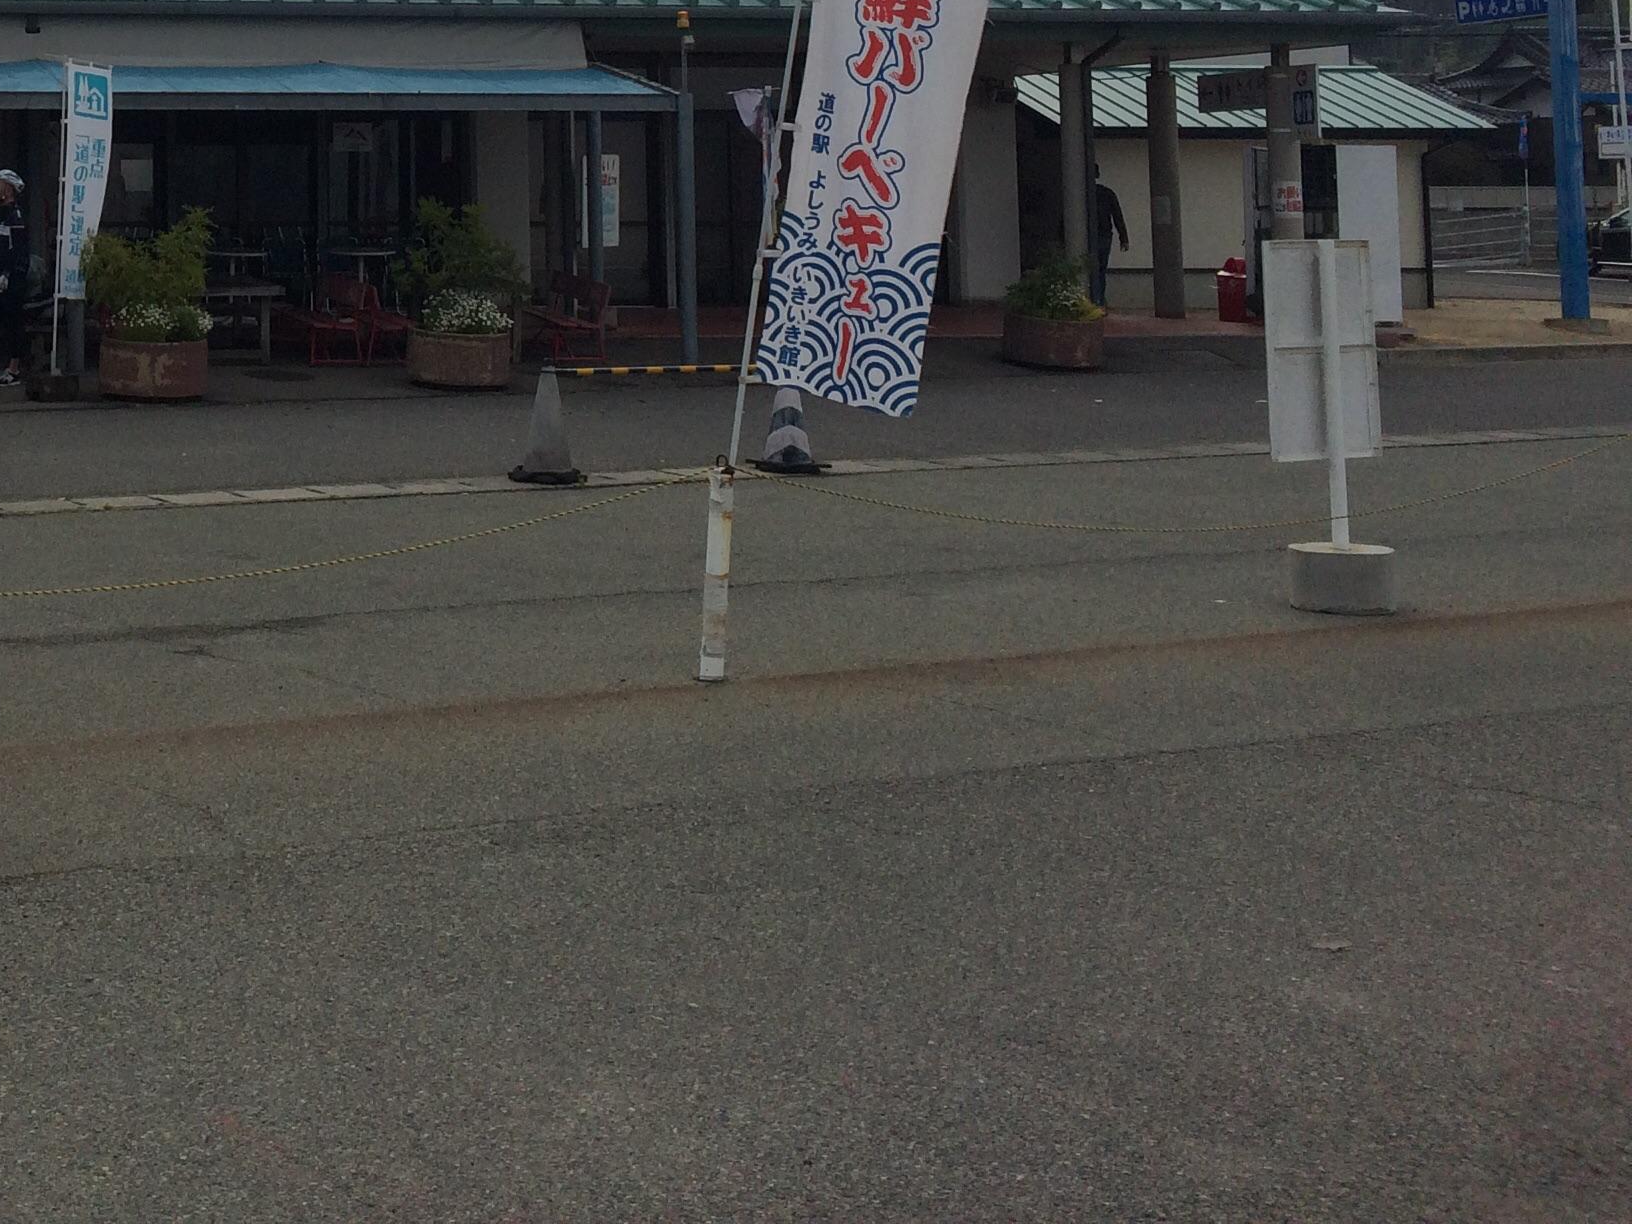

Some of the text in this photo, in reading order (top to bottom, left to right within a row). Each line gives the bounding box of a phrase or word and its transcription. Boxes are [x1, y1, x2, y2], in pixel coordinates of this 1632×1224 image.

[89, 138, 106, 180] 重点
[777, 93, 836, 368] 道の駅 よしうみ いきいき館
